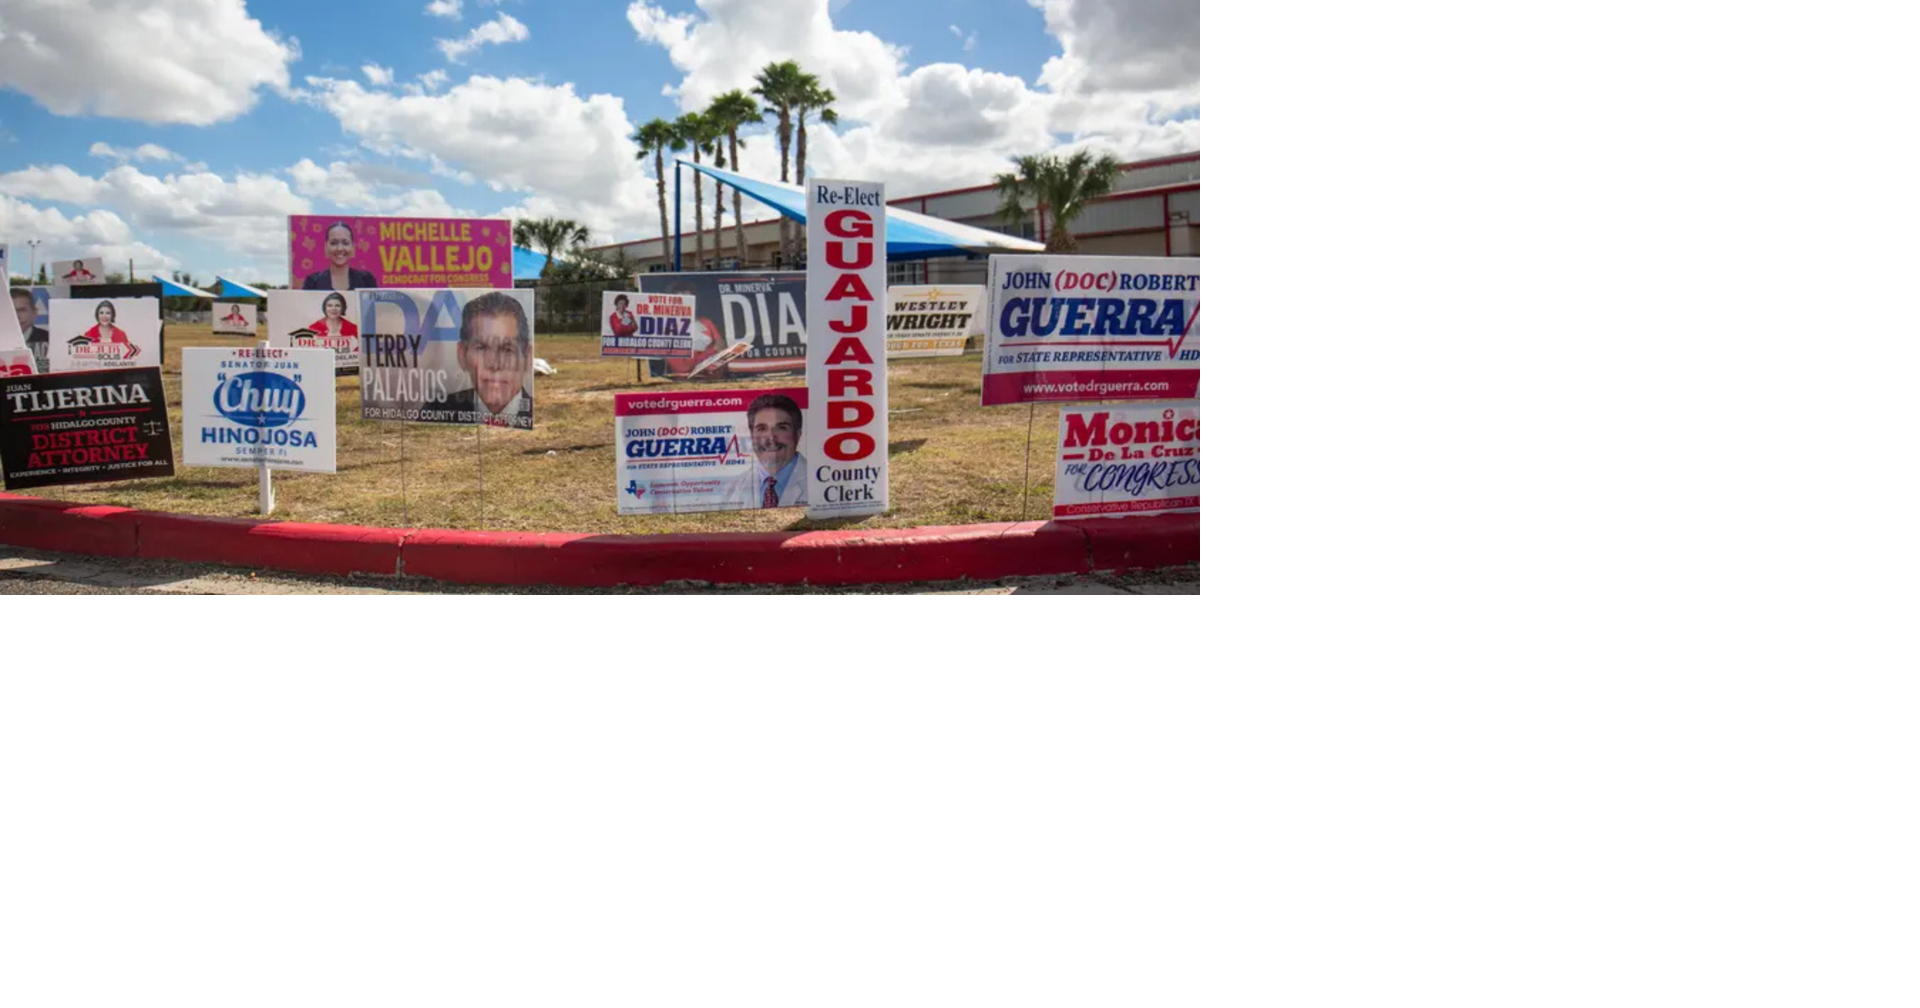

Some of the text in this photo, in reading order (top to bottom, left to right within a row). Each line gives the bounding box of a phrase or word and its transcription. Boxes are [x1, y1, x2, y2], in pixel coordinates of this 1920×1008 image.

[817, 185, 880, 207] Re-Elect
[379, 221, 473, 242] MICHELLE
[378, 245, 493, 272] VALLEJO
[382, 273, 489, 284] DEMOCRAT FOR CONGRESS
[1002, 269, 1200, 292] JOHN (DOC) ROBERT
[718, 283, 772, 293] DR. MINERVA
[649, 295, 682, 304] VOTE FOR
[894, 301, 968, 311] WESTLEY
[637, 304, 692, 316] DR. MINERVA
[1000, 297, 1185, 337] GUERRA
[640, 316, 691, 336] DIAZ
[721, 292, 807, 349] DIA
[887, 313, 972, 330] WRIGHT
[298, 338, 319, 347] DR.
[604, 337, 692, 348] FOR HIDALGO COUNTY CLERK
[823, 209, 876, 462] GUAJARDO
[238, 350, 283, 358] RE-ELECT
[362, 334, 422, 368] TERRY
[765, 346, 805, 357] COUNTY
[998, 355, 1014, 364] FOR
[1016, 351, 1050, 363] STATE
[1053, 351, 1162, 362] REPRESENTATIVE
[221, 361, 270, 369] SENATOR
[6, 384, 31, 392] JUAN
[362, 368, 448, 403] PALACIOS
[1023, 380, 1169, 394] www.votedrguerra.com
[7, 383, 150, 413] TIJERINA
[628, 396, 743, 410] votedrguerra.com
[365, 408, 381, 417] FOR
[382, 408, 420, 420] HIDALGO
[420, 410, 456, 422] COUNTY
[31, 416, 136, 431] FOR HIDALGO COUNTY
[625, 425, 732, 438] JOHN (DOC) ROBERT
[1063, 408, 1200, 447] Monic
[31, 427, 138, 450] DISTRICT
[201, 427, 318, 448] HINOJOSA
[27, 443, 149, 468] ATTORNEY
[236, 447, 275, 455] SEMPER
[626, 437, 727, 458] GUERRA
[1088, 445, 1194, 461] De La Cruz
[10, 468, 57, 478] EXPERIENCE
[62, 465, 100, 474] INTEGRITY
[107, 462, 137, 470] JUSTICE
[816, 465, 881, 484] County
[1065, 463, 1088, 475] FOR
[681, 480, 721, 488] Opportunity
[824, 484, 874, 503] Clerk
[1067, 503, 1129, 514] Conservative
[1131, 498, 1182, 510] Republican
